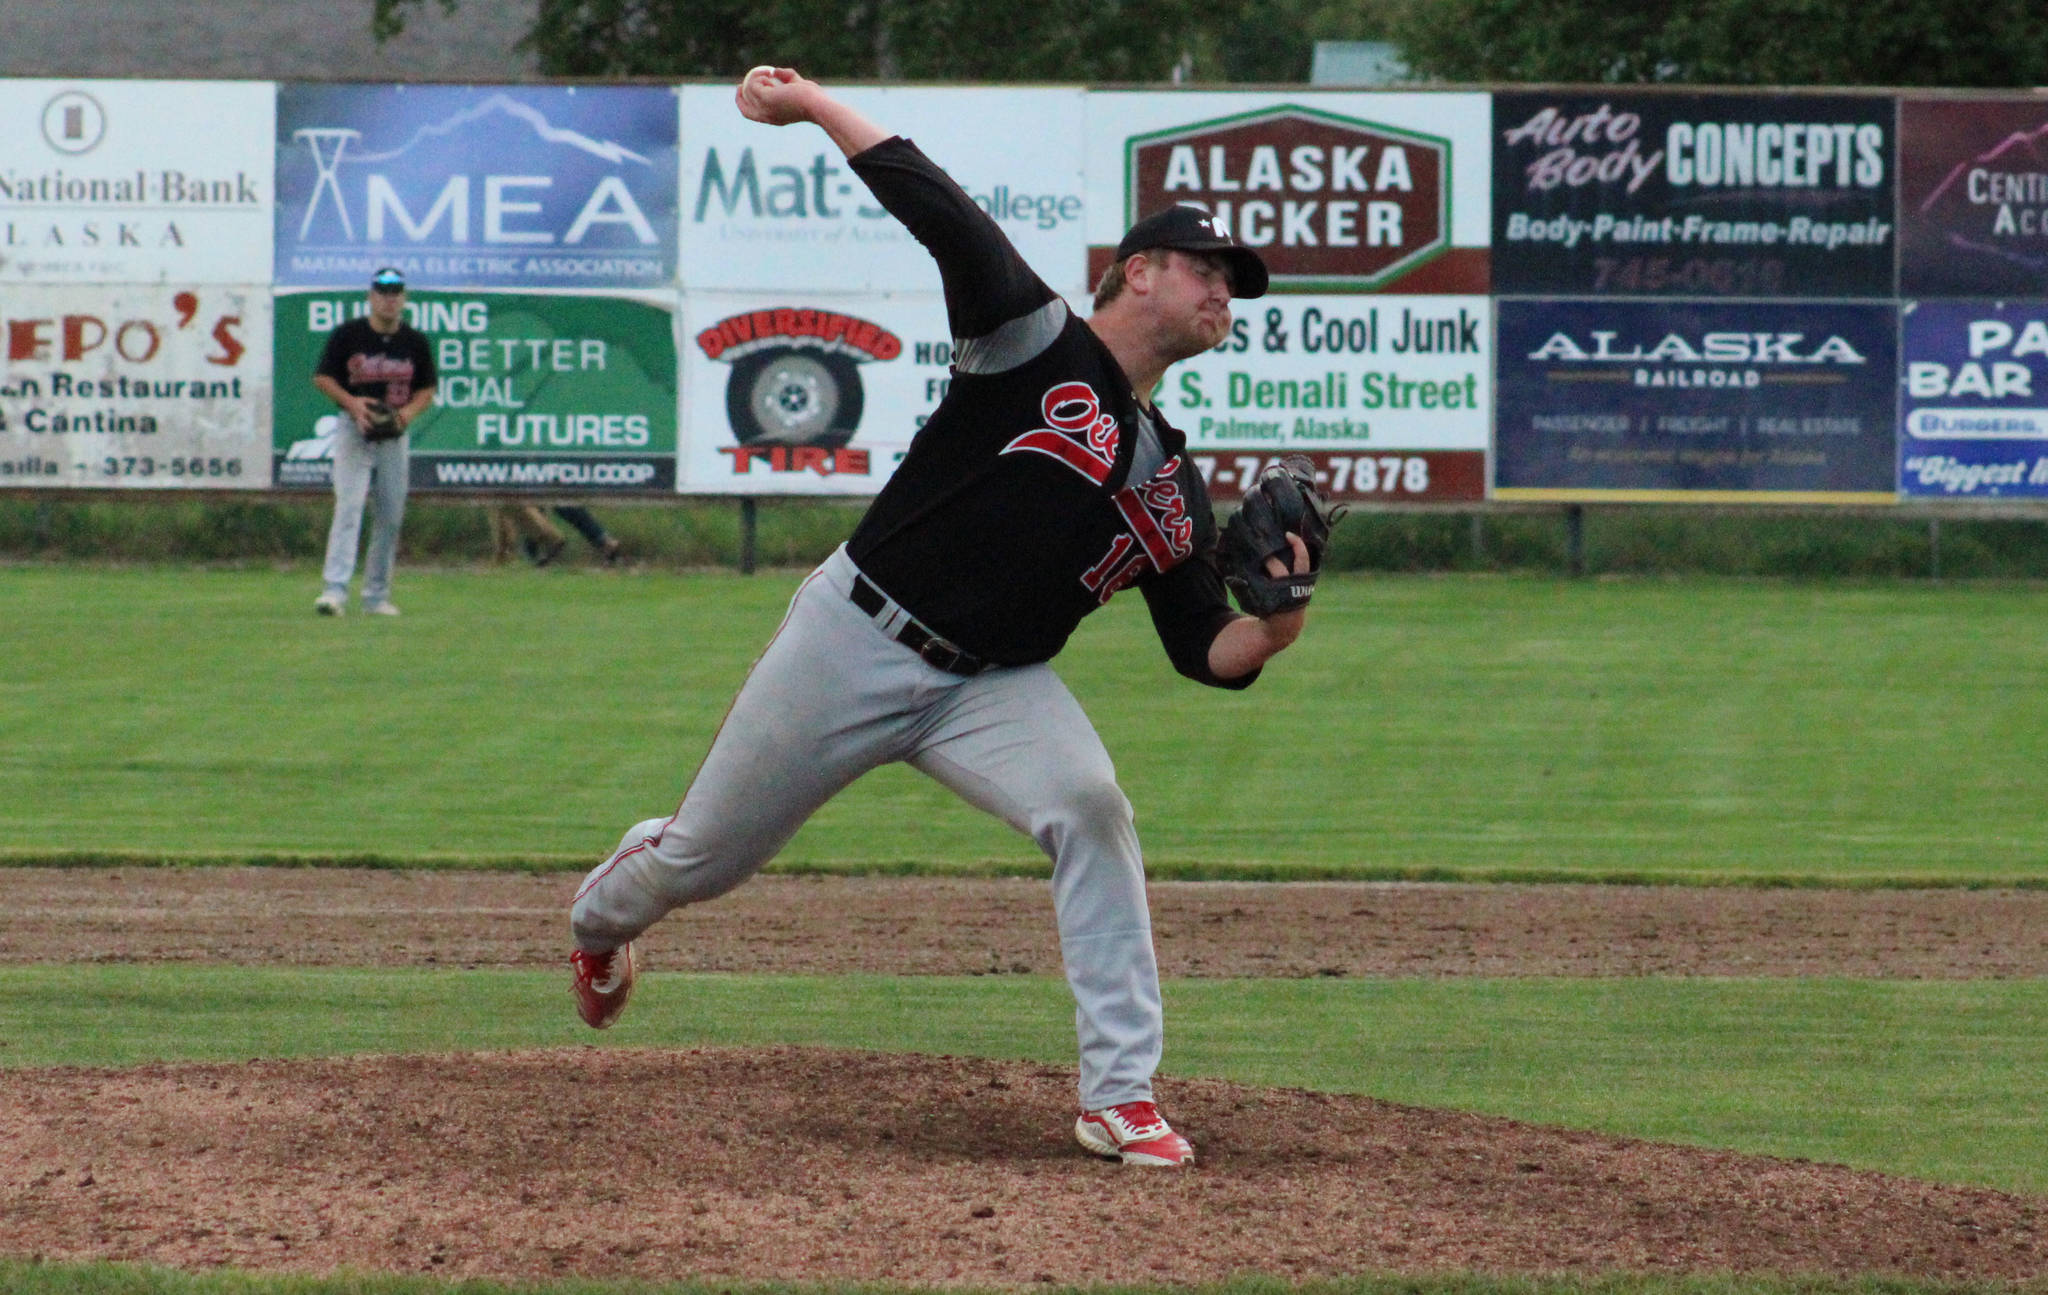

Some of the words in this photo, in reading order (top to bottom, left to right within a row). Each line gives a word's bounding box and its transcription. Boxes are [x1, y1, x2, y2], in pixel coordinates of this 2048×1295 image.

[1503, 104, 1641, 147] Auto
[1164, 144, 1414, 192] ALASKA
[1525, 139, 1664, 194] Body
[1666, 122, 1884, 188] CONCEPTS
[161, 170, 258, 203] Bank
[367, 174, 660, 244] MEA
[963, 184, 1083, 230] ollege
[1176, 199, 1404, 248] ICKER
[425, 256, 518, 275] ELECTRIC
[524, 257, 663, 277] ASSOCIATION
[0, 291, 246, 368] EPO'S
[697, 307, 902, 361] DIVERSIFIED
[1263, 307, 1288, 353] &
[1303, 307, 1378, 353] Cool
[1392, 308, 1481, 354] Junk
[1528, 331, 1867, 363] ALASKA
[438, 339, 606, 371] BETTER
[51, 372, 242, 399] Restaurant
[1179, 371, 1213, 409] S.
[1228, 371, 1348, 409] Denali
[1362, 371, 1478, 410] Street
[1634, 369, 1761, 388] RAILROAD
[1907, 361, 2035, 399] BAR
[24, 408, 158, 433] Cantina
[477, 414, 650, 446] FUTURES
[1200, 416, 1286, 442] Palmer,
[1293, 416, 1370, 441] Alaska
[437, 462, 654, 484] WWW.MVFCU.COOP
[717, 445, 871, 477] TIRE
